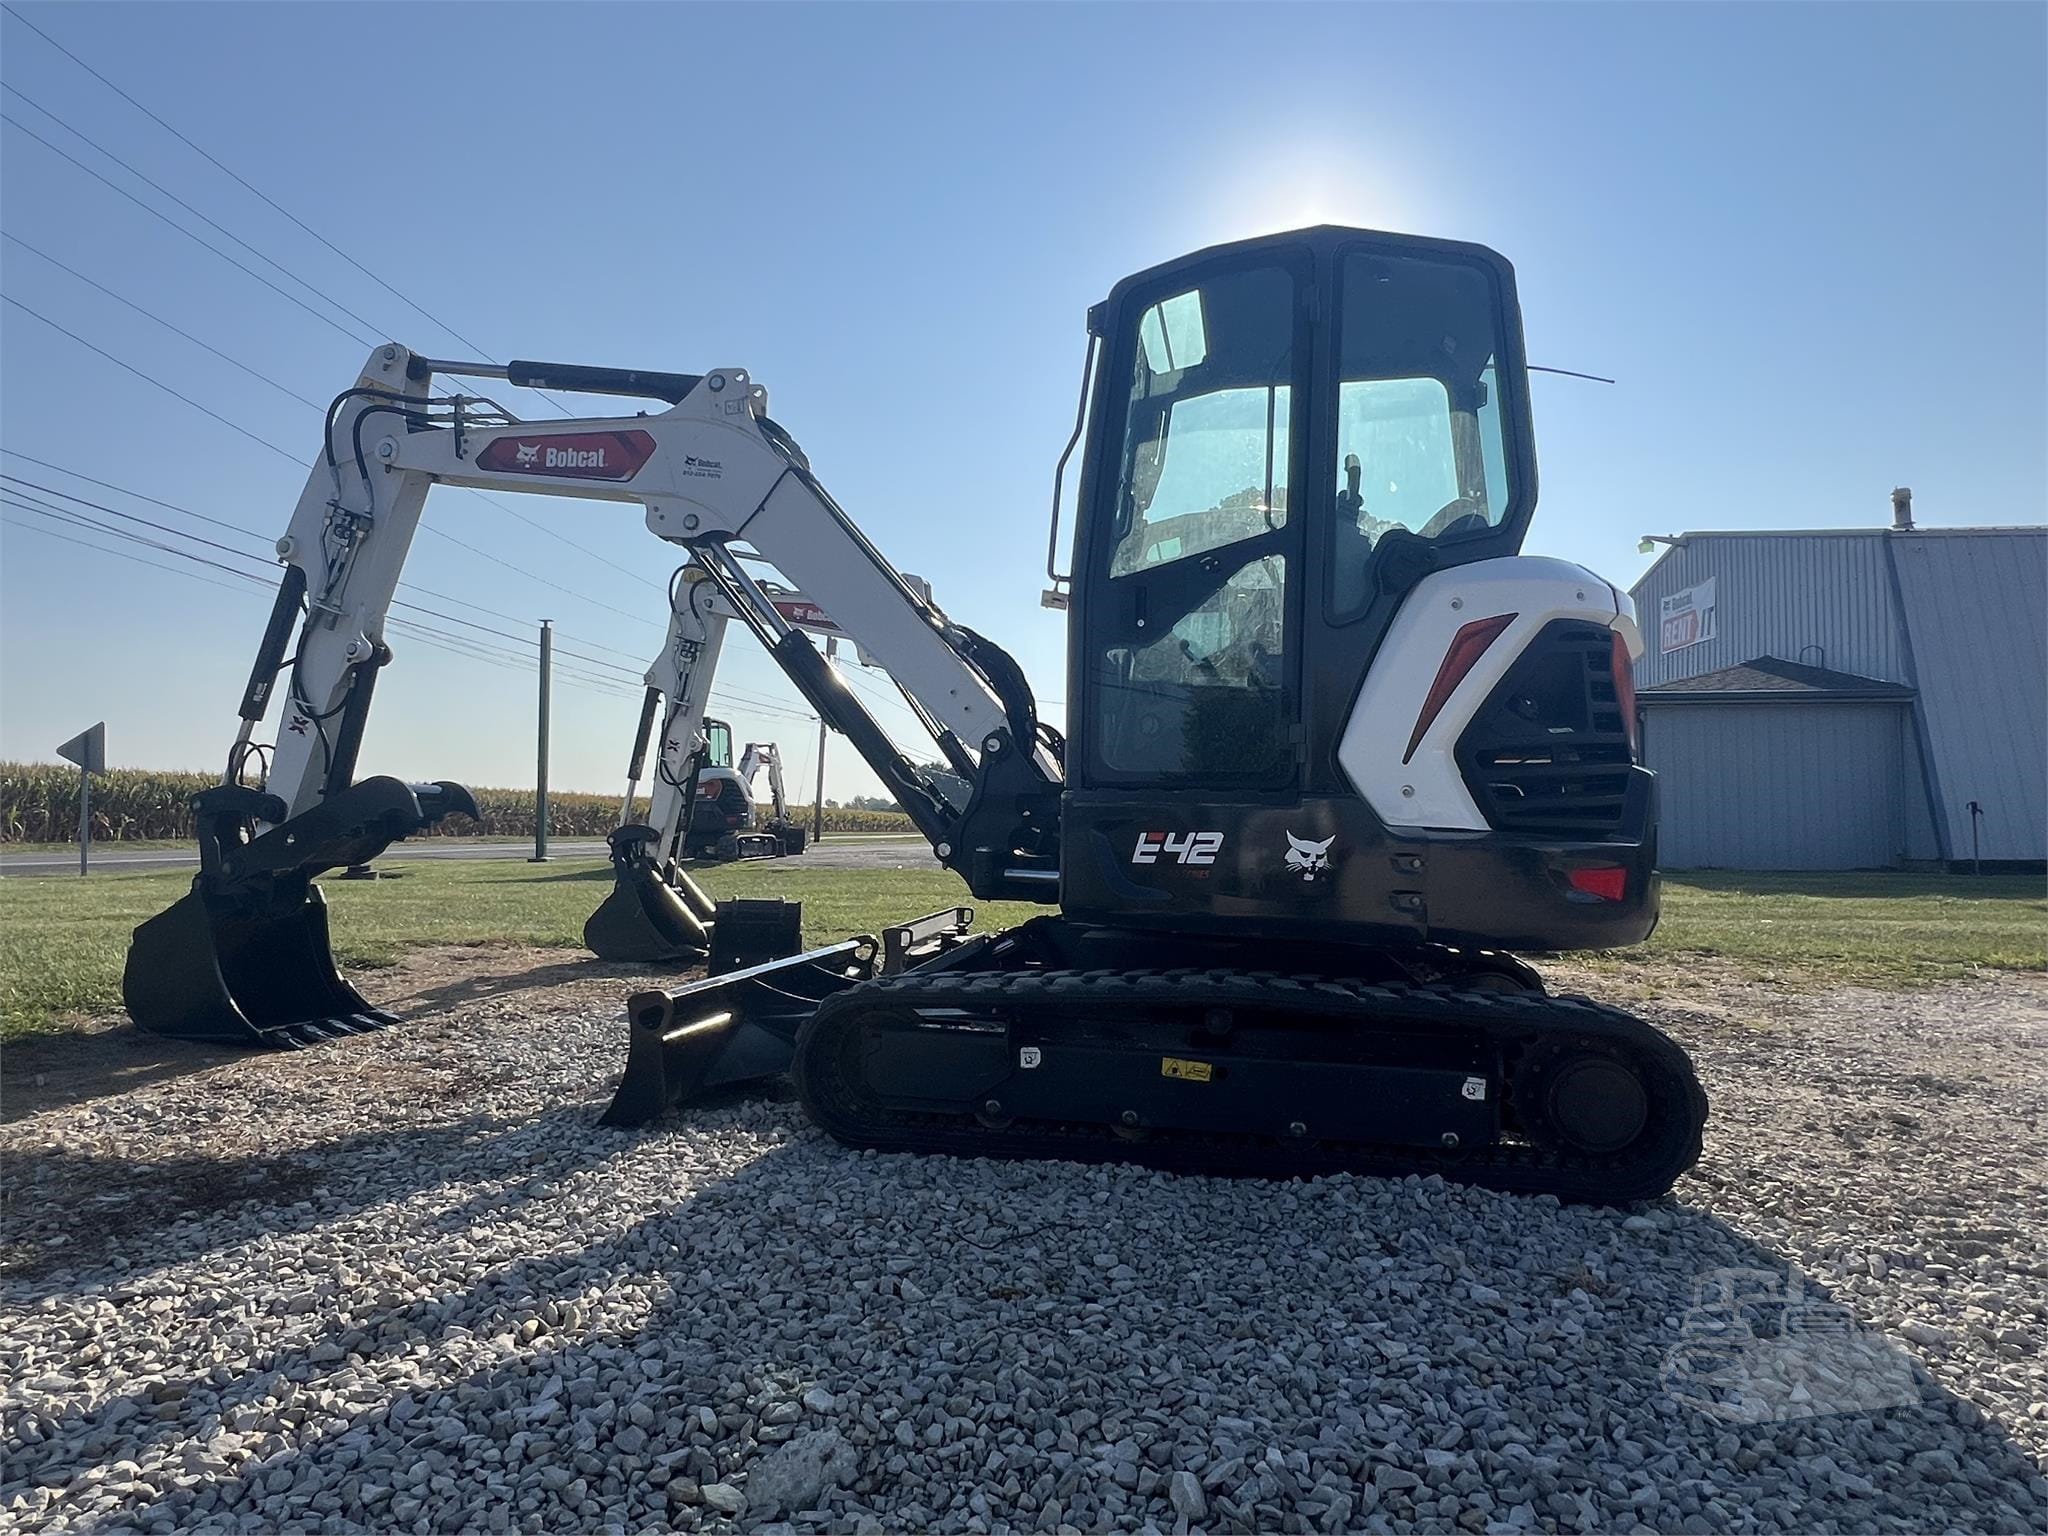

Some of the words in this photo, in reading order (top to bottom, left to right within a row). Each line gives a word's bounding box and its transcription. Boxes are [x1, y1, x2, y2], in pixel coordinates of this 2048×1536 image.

[545, 447, 606, 468] Bobcat
[697, 459, 721, 468] Bobcat
[1664, 614, 1694, 645] RENT
[1700, 606, 1715, 638] IT
[1131, 831, 1225, 864] E42
